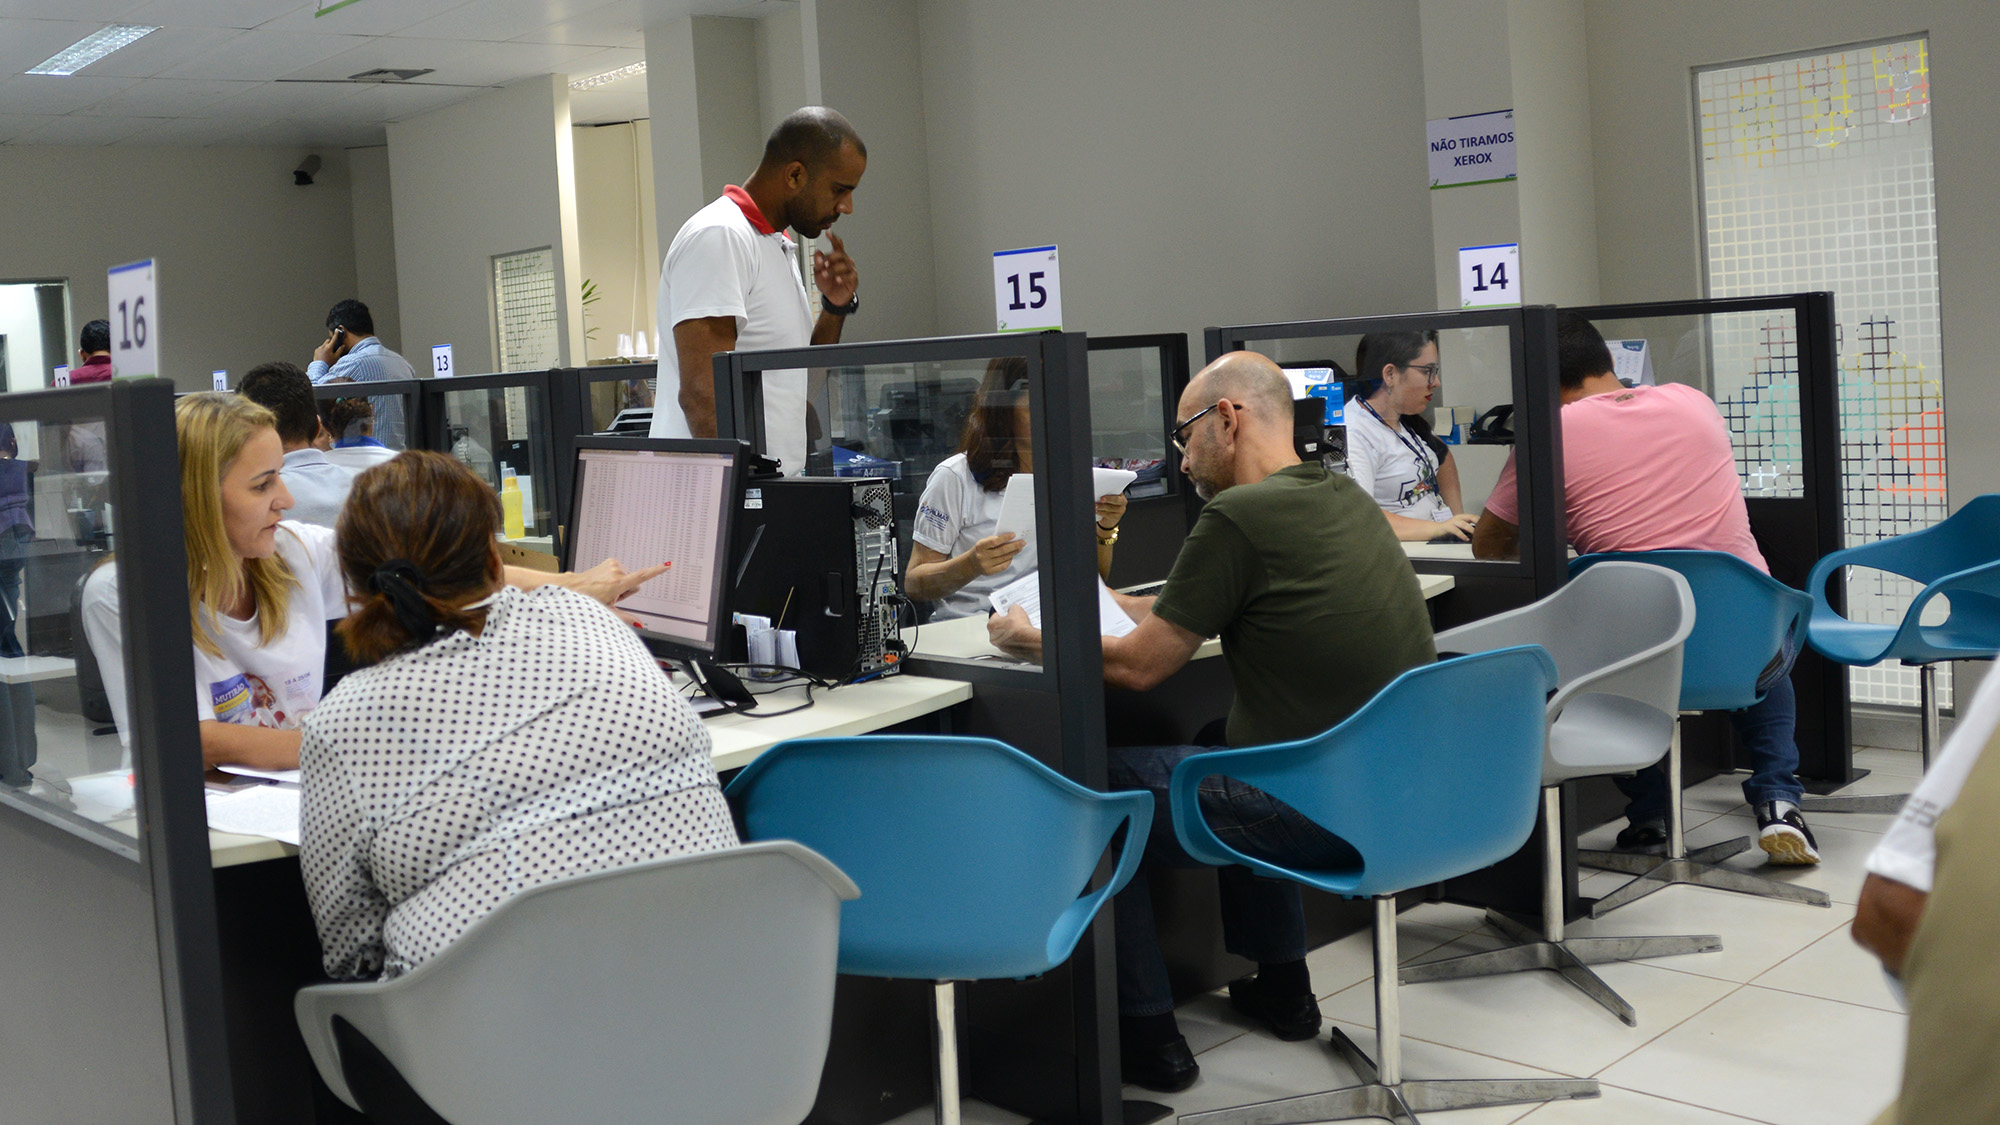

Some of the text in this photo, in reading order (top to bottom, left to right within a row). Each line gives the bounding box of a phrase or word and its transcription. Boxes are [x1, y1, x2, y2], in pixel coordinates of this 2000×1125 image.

[1431, 132, 1514, 152] NÃO TIRAMOS
[1454, 152, 1492, 167] XEROX
[1472, 262, 1509, 291] 14
[1007, 271, 1047, 310] 15
[118, 295, 146, 350] 16
[437, 355, 449, 371] 13
[215, 379, 224, 391] 01
[863, 468, 874, 477] A4
